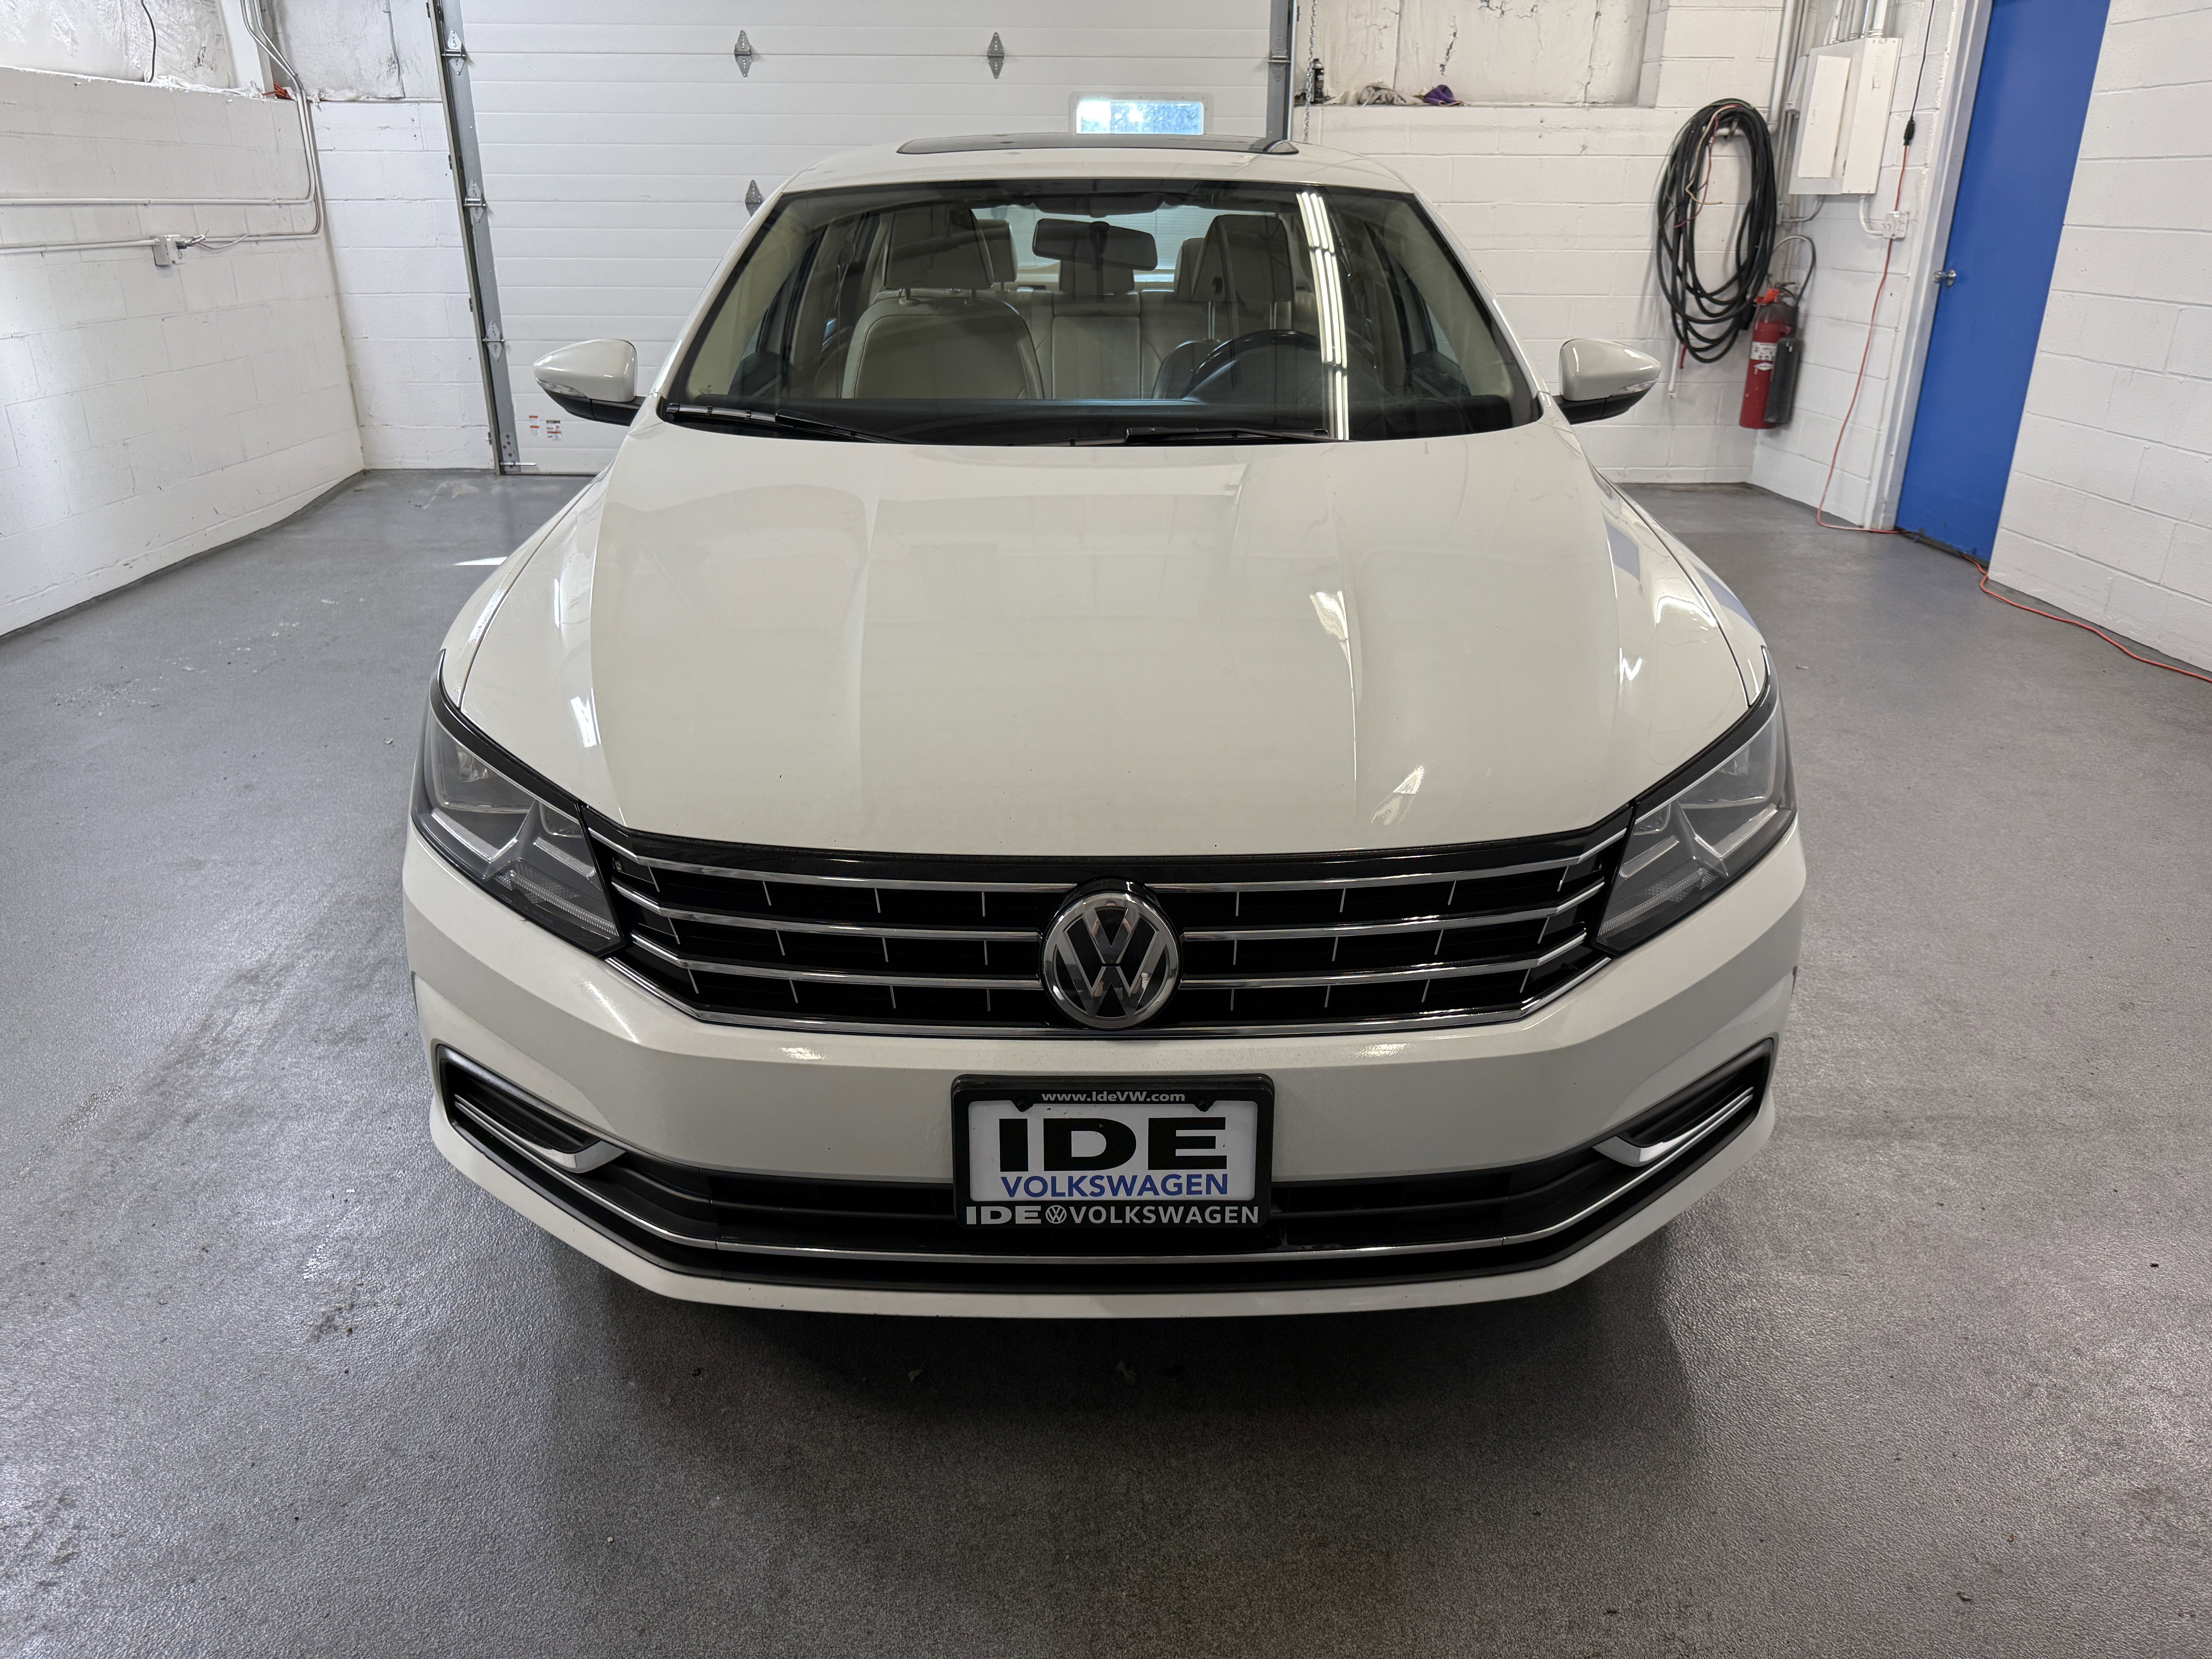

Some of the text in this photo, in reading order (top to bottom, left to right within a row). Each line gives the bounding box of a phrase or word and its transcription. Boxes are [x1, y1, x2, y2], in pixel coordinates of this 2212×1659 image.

[1041, 1091, 1185, 1101] www.IdeVW.com
[999, 1117, 1227, 1172] IDE
[1001, 1173, 1228, 1198] VOLKSWAGEN
[966, 1206, 1041, 1224] IDE
[1069, 1206, 1259, 1224] VOLKSWAGEN
